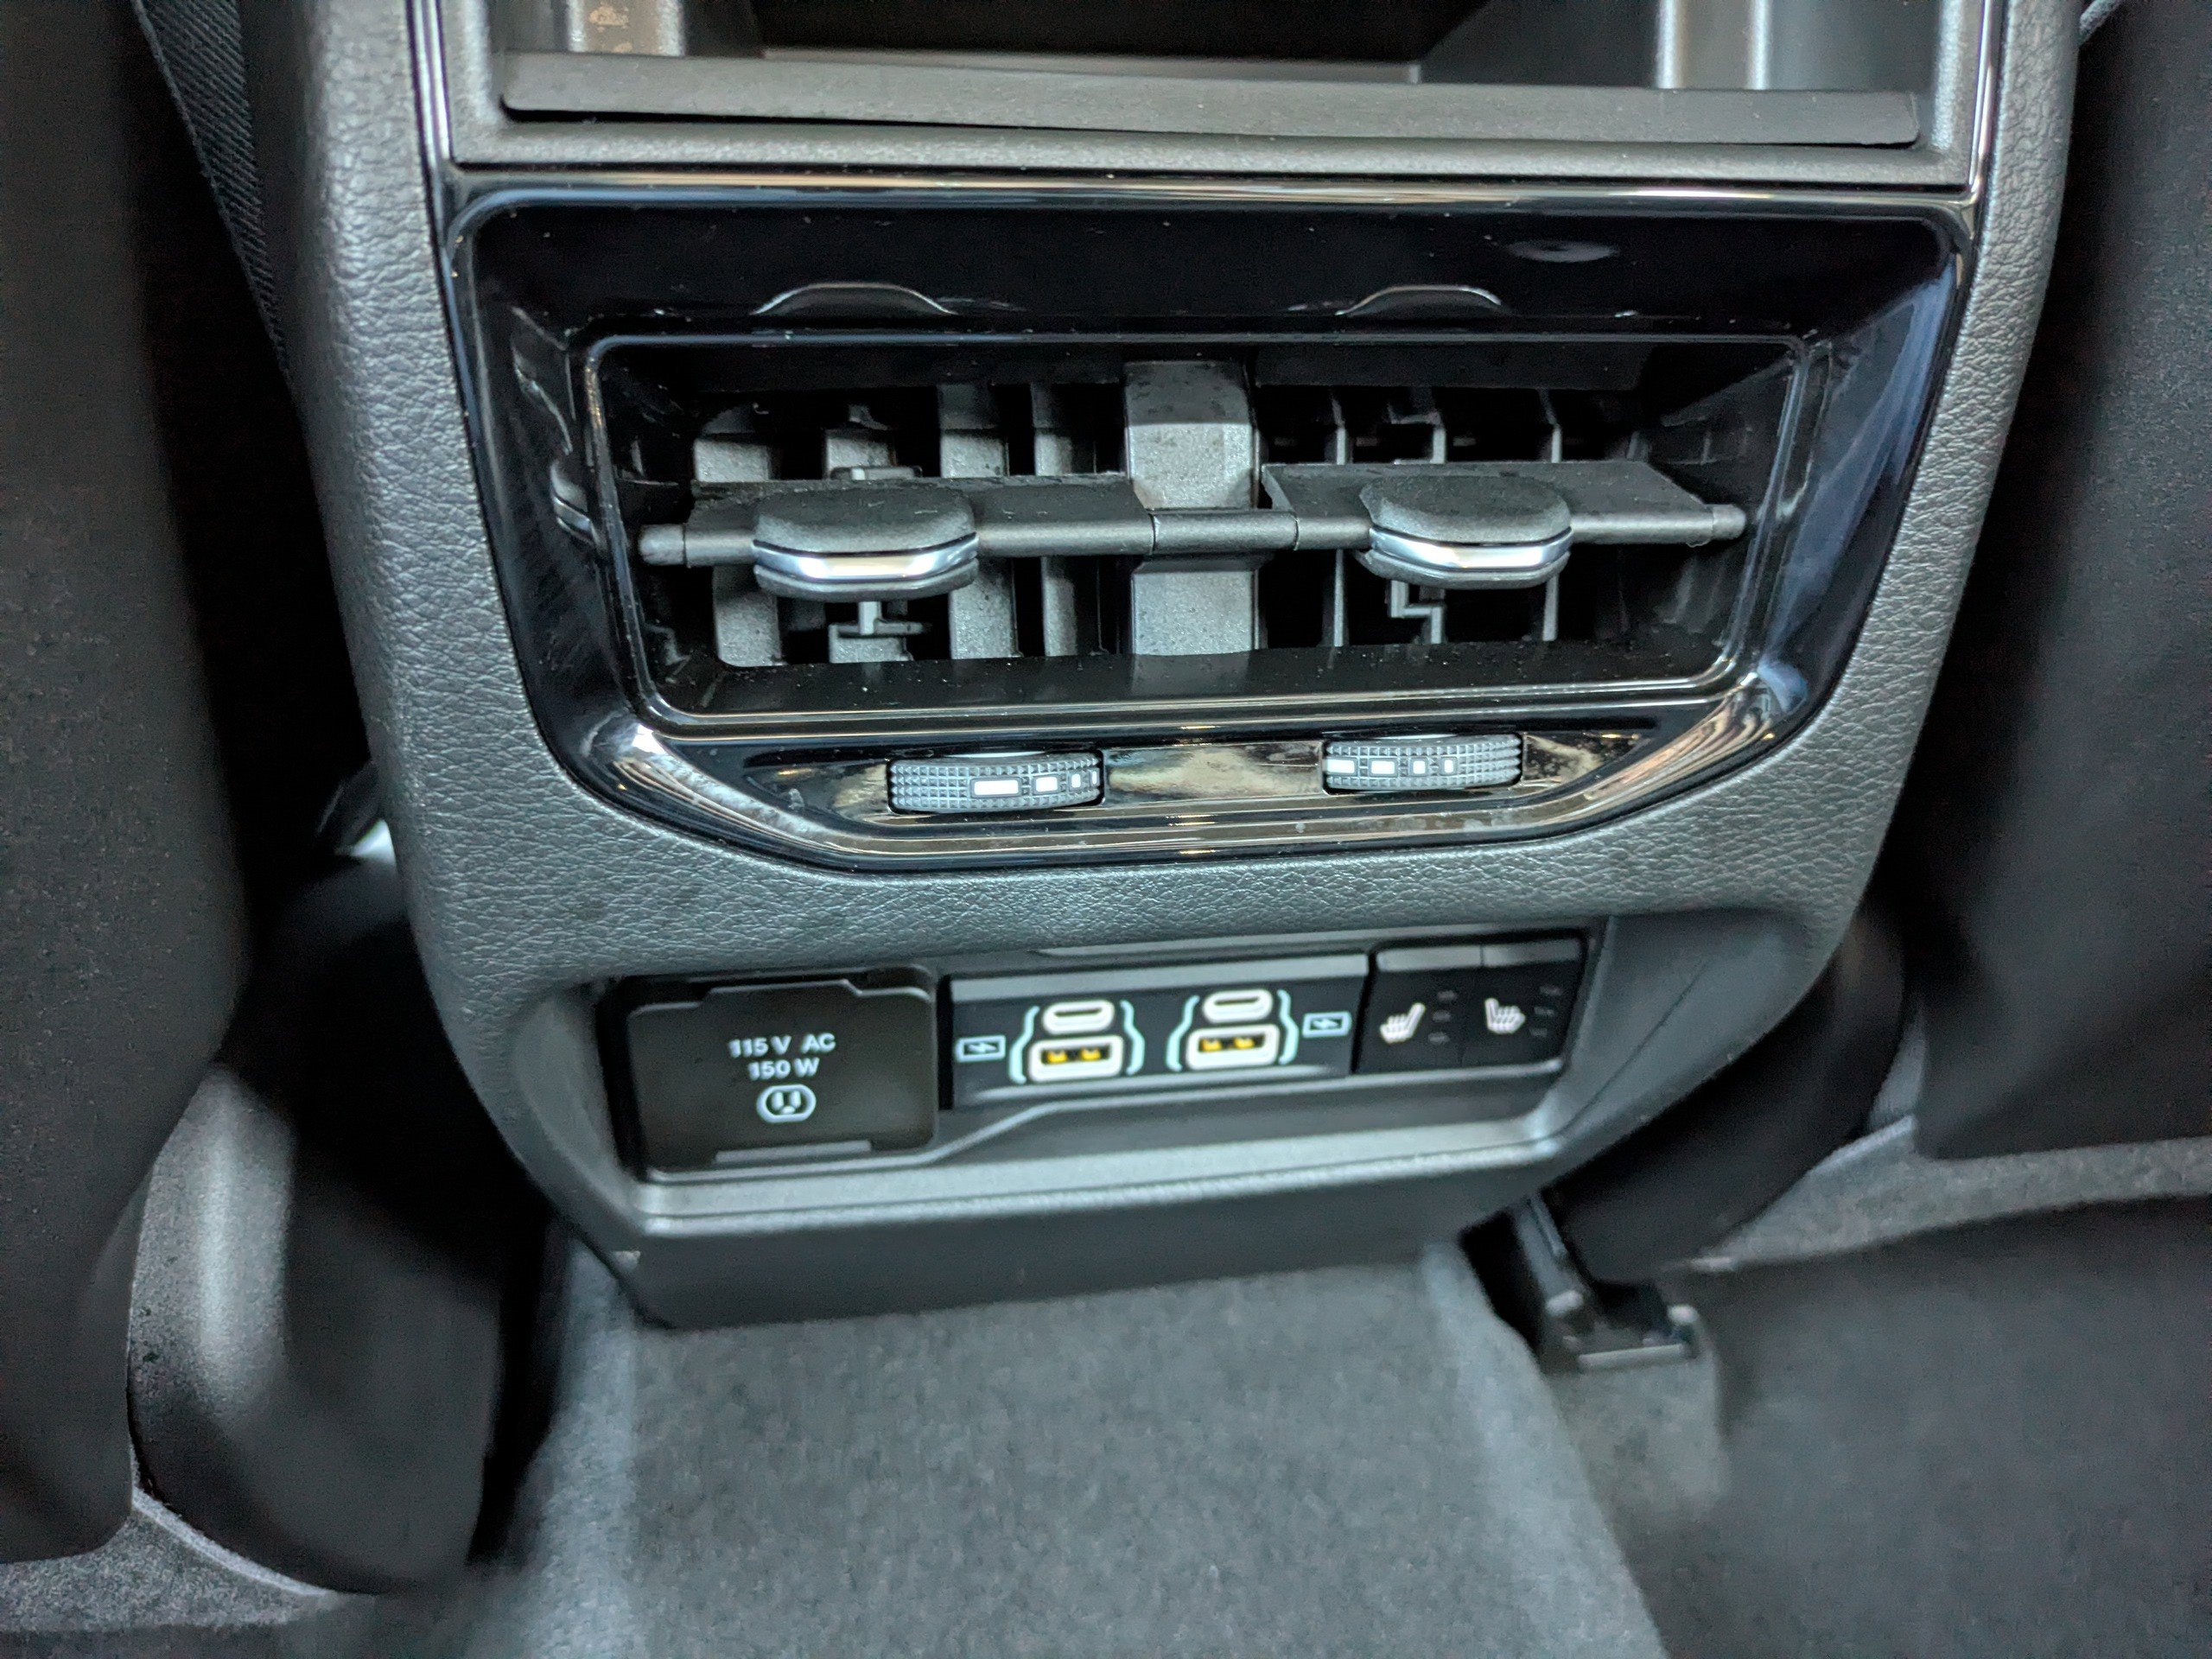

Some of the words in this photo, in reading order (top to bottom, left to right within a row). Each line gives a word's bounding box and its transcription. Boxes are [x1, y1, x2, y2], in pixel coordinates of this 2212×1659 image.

[728, 1037, 769, 1058] 115
[771, 1034, 792, 1055] V
[800, 1033, 836, 1054] AC
[747, 1059, 791, 1080] 150
[794, 1057, 820, 1077] W
